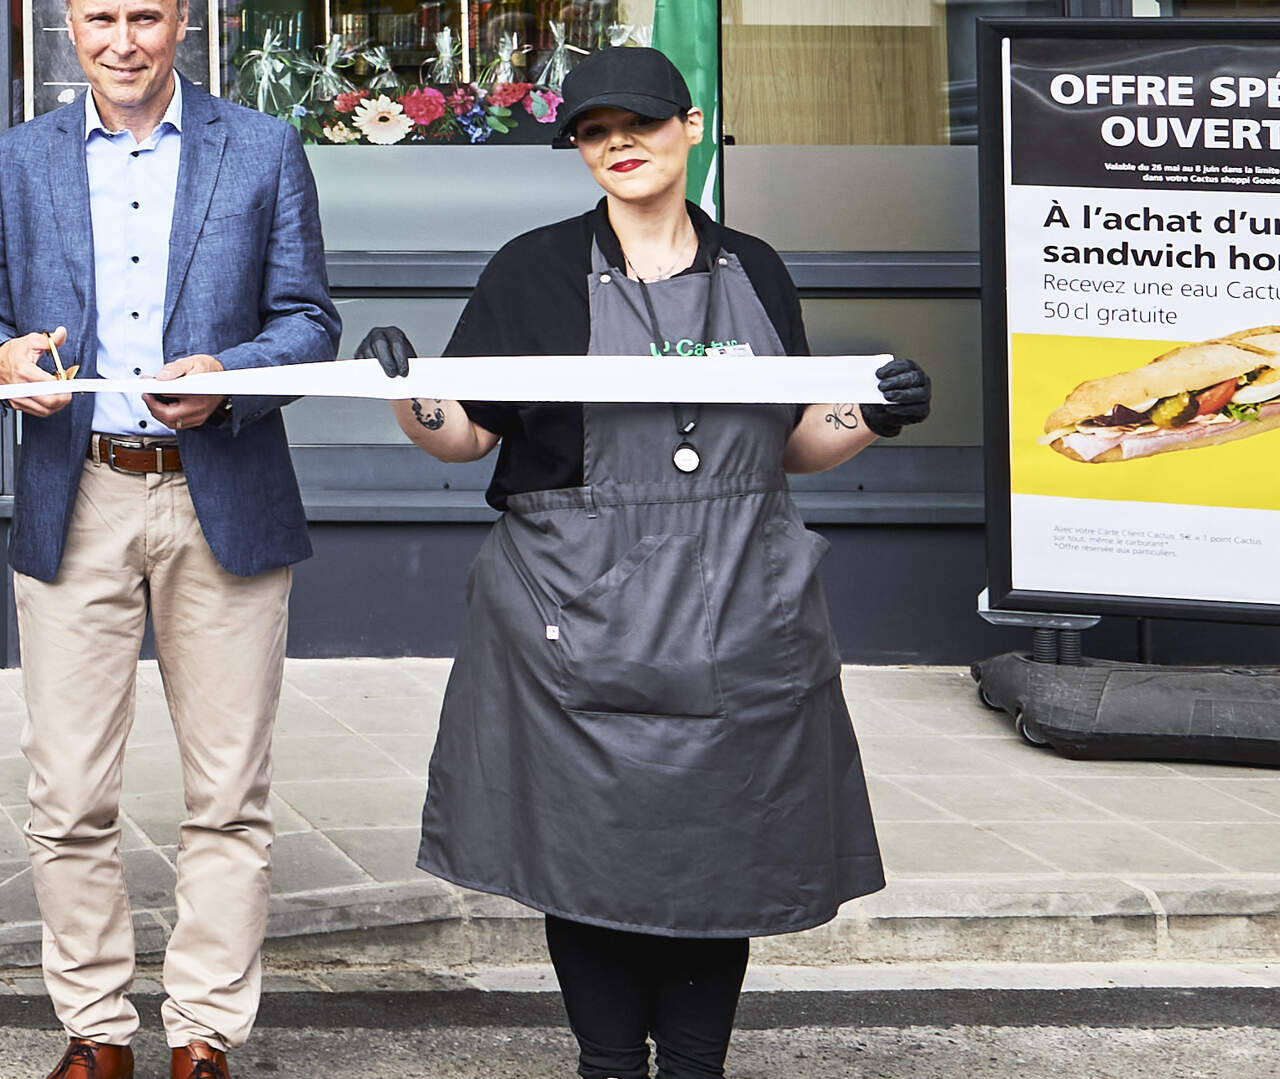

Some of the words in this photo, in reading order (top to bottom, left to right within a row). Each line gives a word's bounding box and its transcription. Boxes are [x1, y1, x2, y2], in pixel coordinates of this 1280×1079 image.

[1049, 73, 1195, 107] OFFRE
[1100, 115, 1280, 151] OUVERT
[1104, 162, 1136, 171] Valable
[1137, 163, 1150, 171] du
[1163, 164, 1180, 172] mai
[1202, 165, 1220, 174] juin
[1221, 165, 1243, 173] dans
[1244, 166, 1253, 174] la
[1142, 174, 1163, 182] dans
[1190, 175, 1219, 183] Cactus
[1221, 175, 1250, 185] shoppi
[1043, 200, 1070, 228] À
[1083, 204, 1202, 233] l'achat
[1043, 241, 1216, 269] sandwich
[1044, 274, 1125, 295] Recevez
[1134, 281, 1173, 296] une
[1180, 282, 1218, 297] eau
[1097, 305, 1177, 325] gratuite
